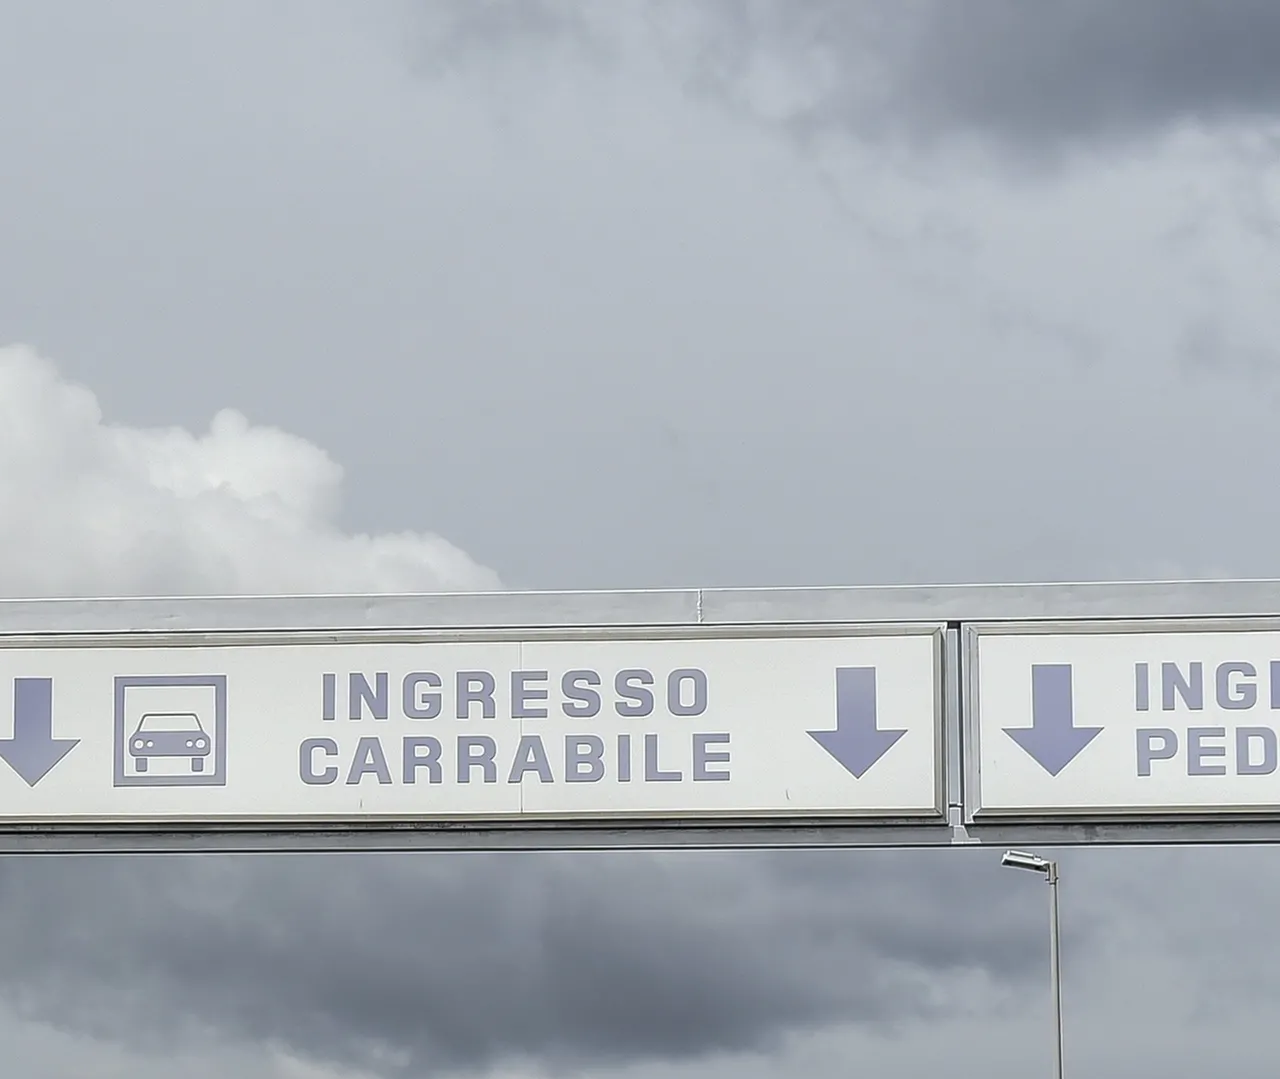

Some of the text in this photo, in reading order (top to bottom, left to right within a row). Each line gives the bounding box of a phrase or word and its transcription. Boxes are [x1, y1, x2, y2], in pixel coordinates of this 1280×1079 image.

[324, 669, 708, 721] INGRESSO
[1135, 660, 1280, 711] ING
[298, 733, 732, 785] CARRABILE
